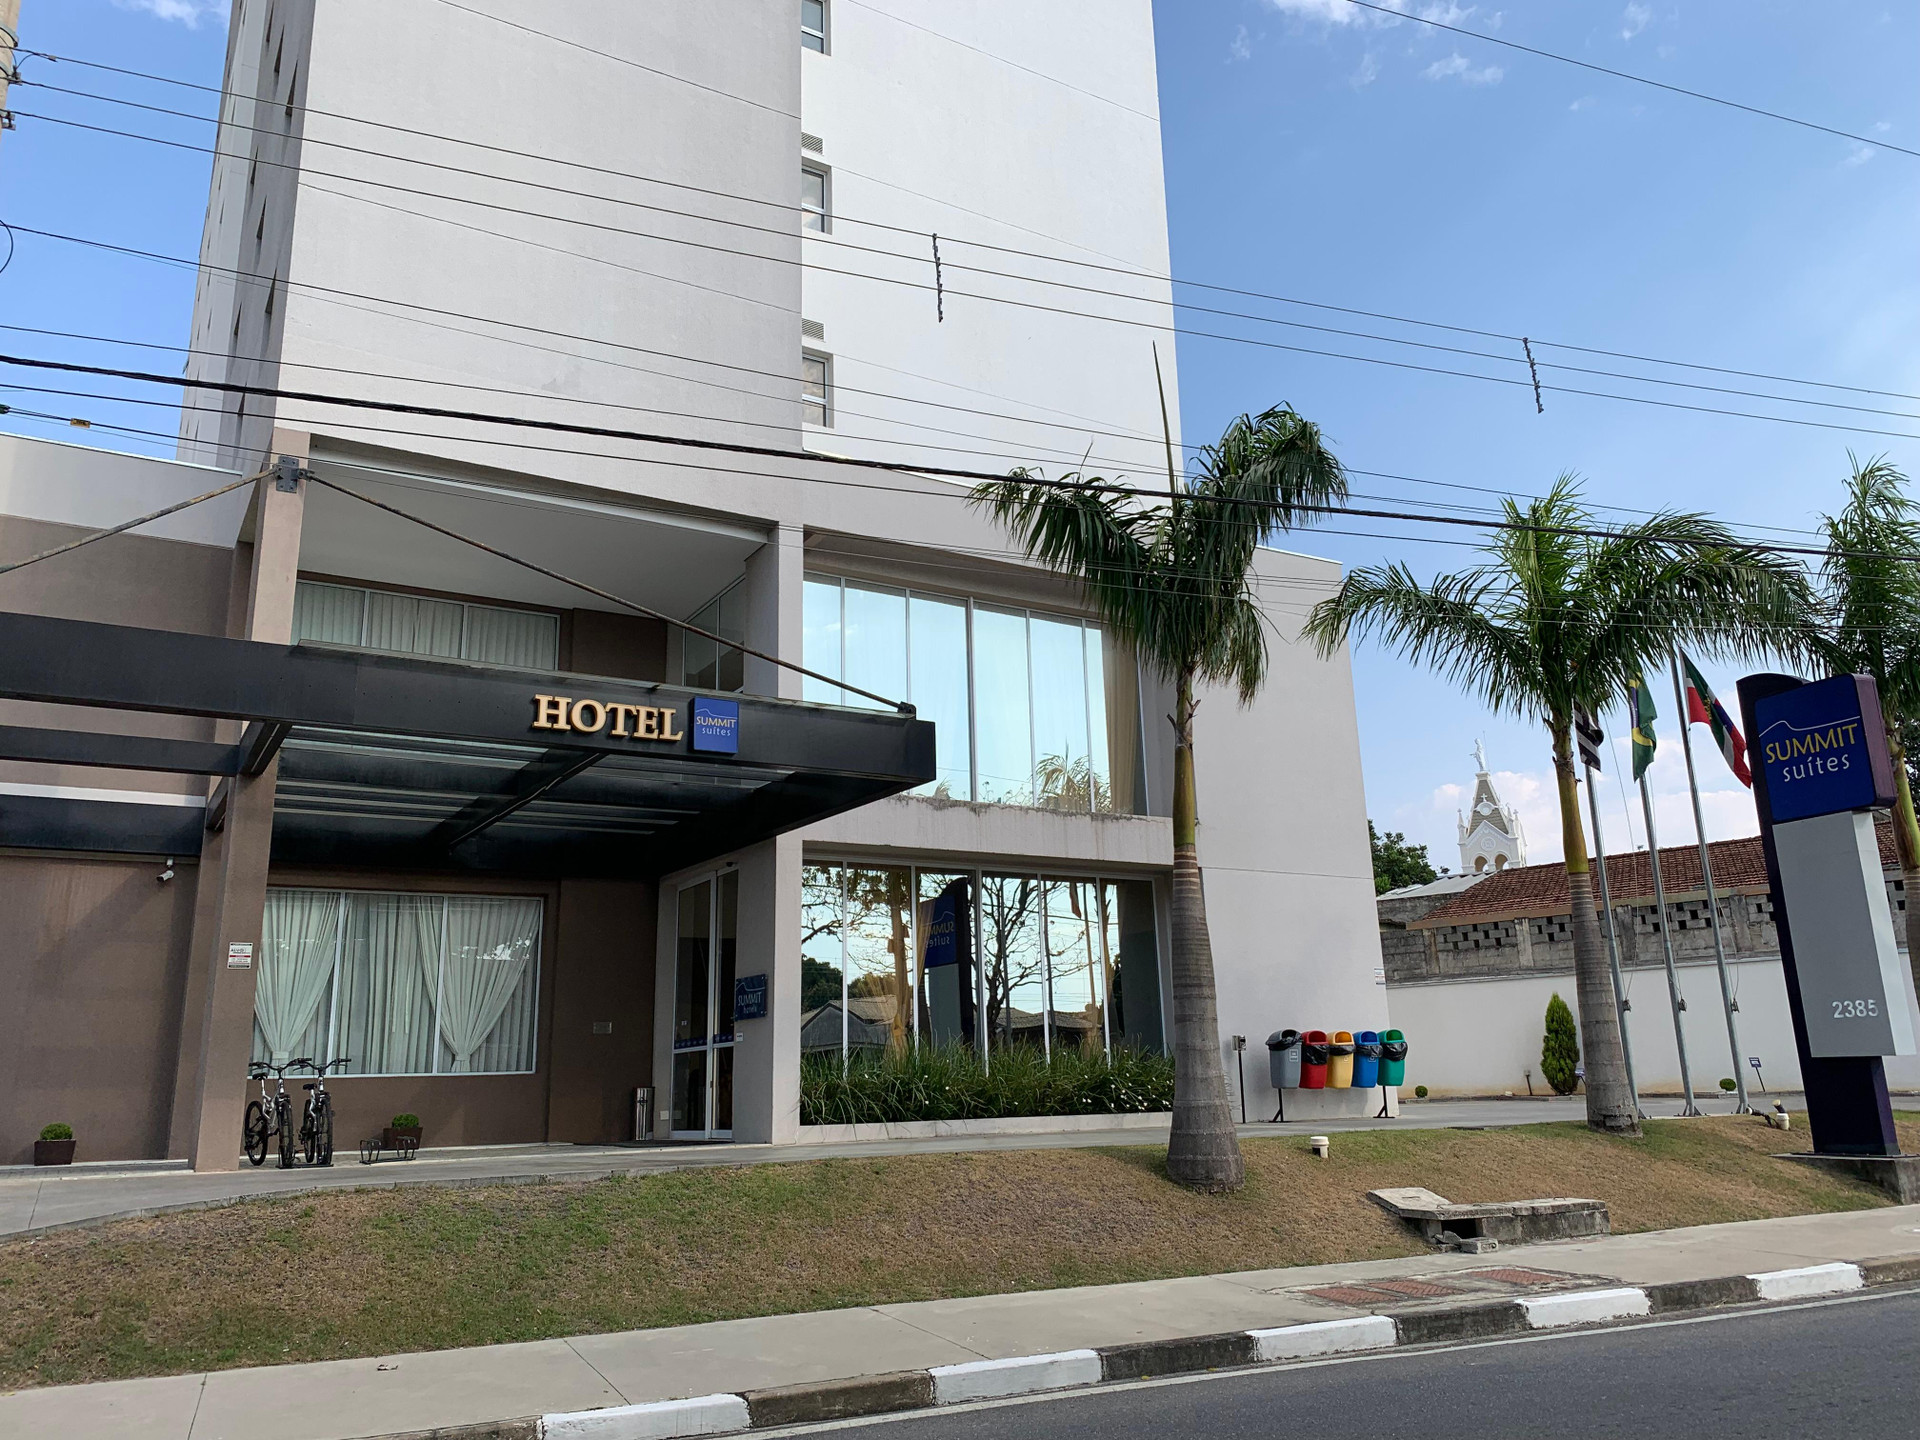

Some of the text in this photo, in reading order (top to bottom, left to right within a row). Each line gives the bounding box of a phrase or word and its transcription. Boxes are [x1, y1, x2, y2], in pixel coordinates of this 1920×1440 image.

[532, 694, 684, 742] HOTEL
[696, 715, 737, 728] SUMMIT
[1765, 723, 1858, 764] SUMMIT
[1783, 754, 1850, 782] suítes
[738, 991, 762, 1006] SUMMIT
[1832, 999, 1879, 1019] 2385
